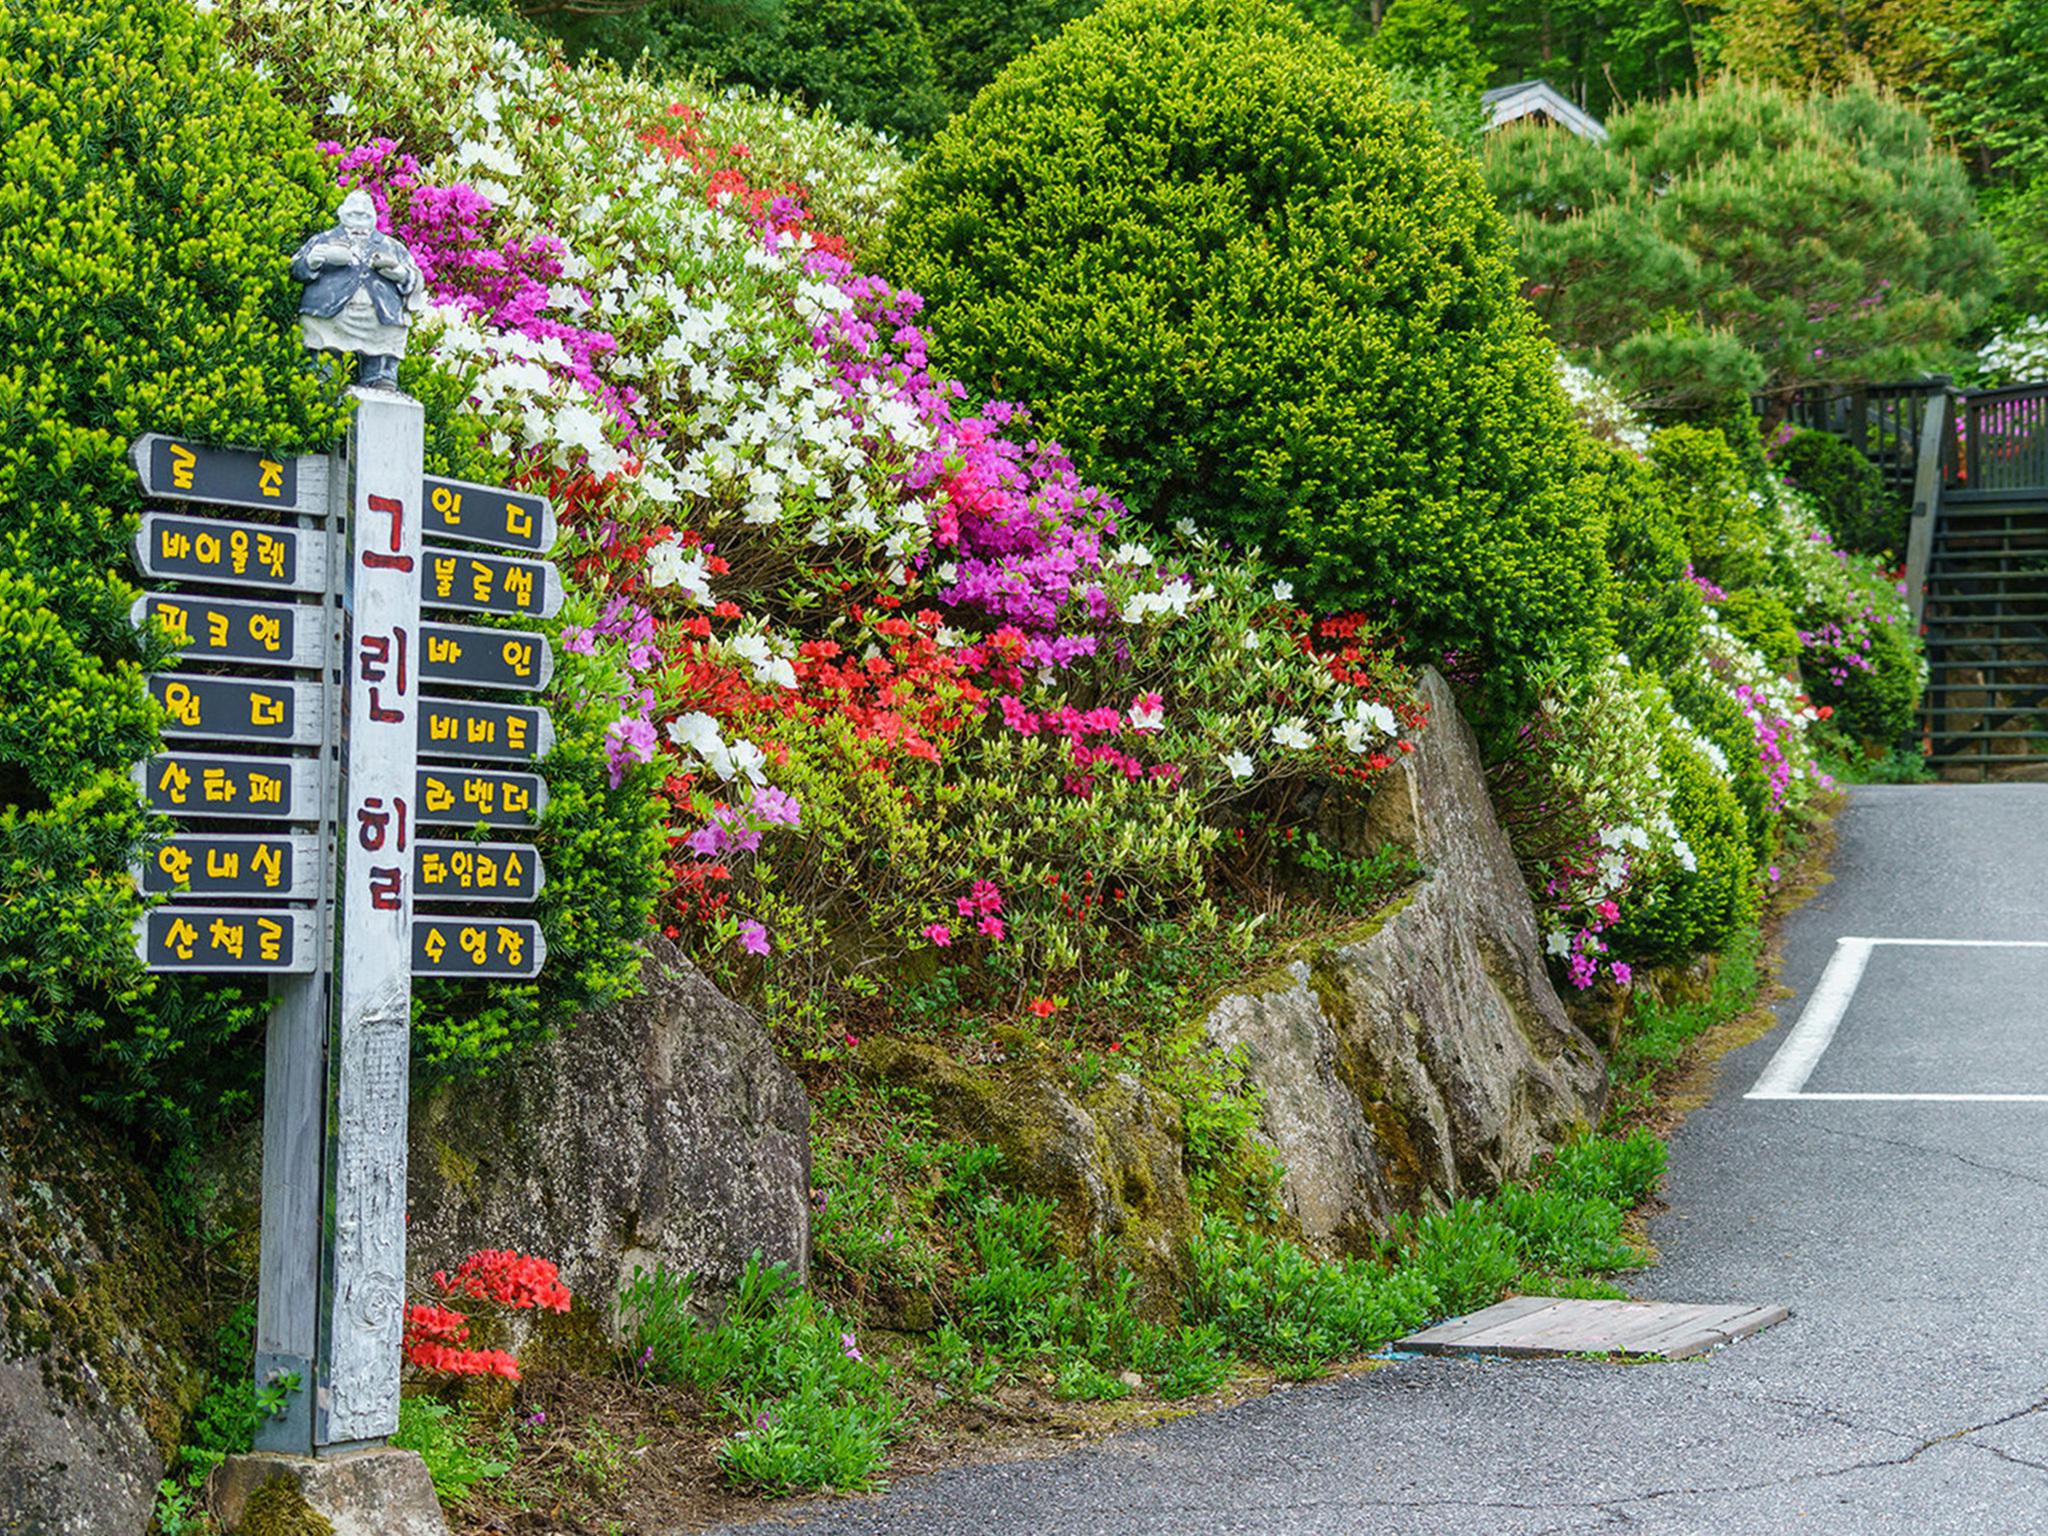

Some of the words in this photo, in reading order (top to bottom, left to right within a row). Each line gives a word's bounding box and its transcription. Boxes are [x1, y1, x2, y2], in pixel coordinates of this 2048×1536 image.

[430, 714, 528, 750] 비비드
[159, 761, 282, 803] 산타페
[425, 777, 529, 814] 라벤더
[158, 843, 282, 887] 안내실
[422, 850, 524, 888] 타임리스
[164, 917, 283, 961] 산책로
[424, 926, 524, 966] 수영장
